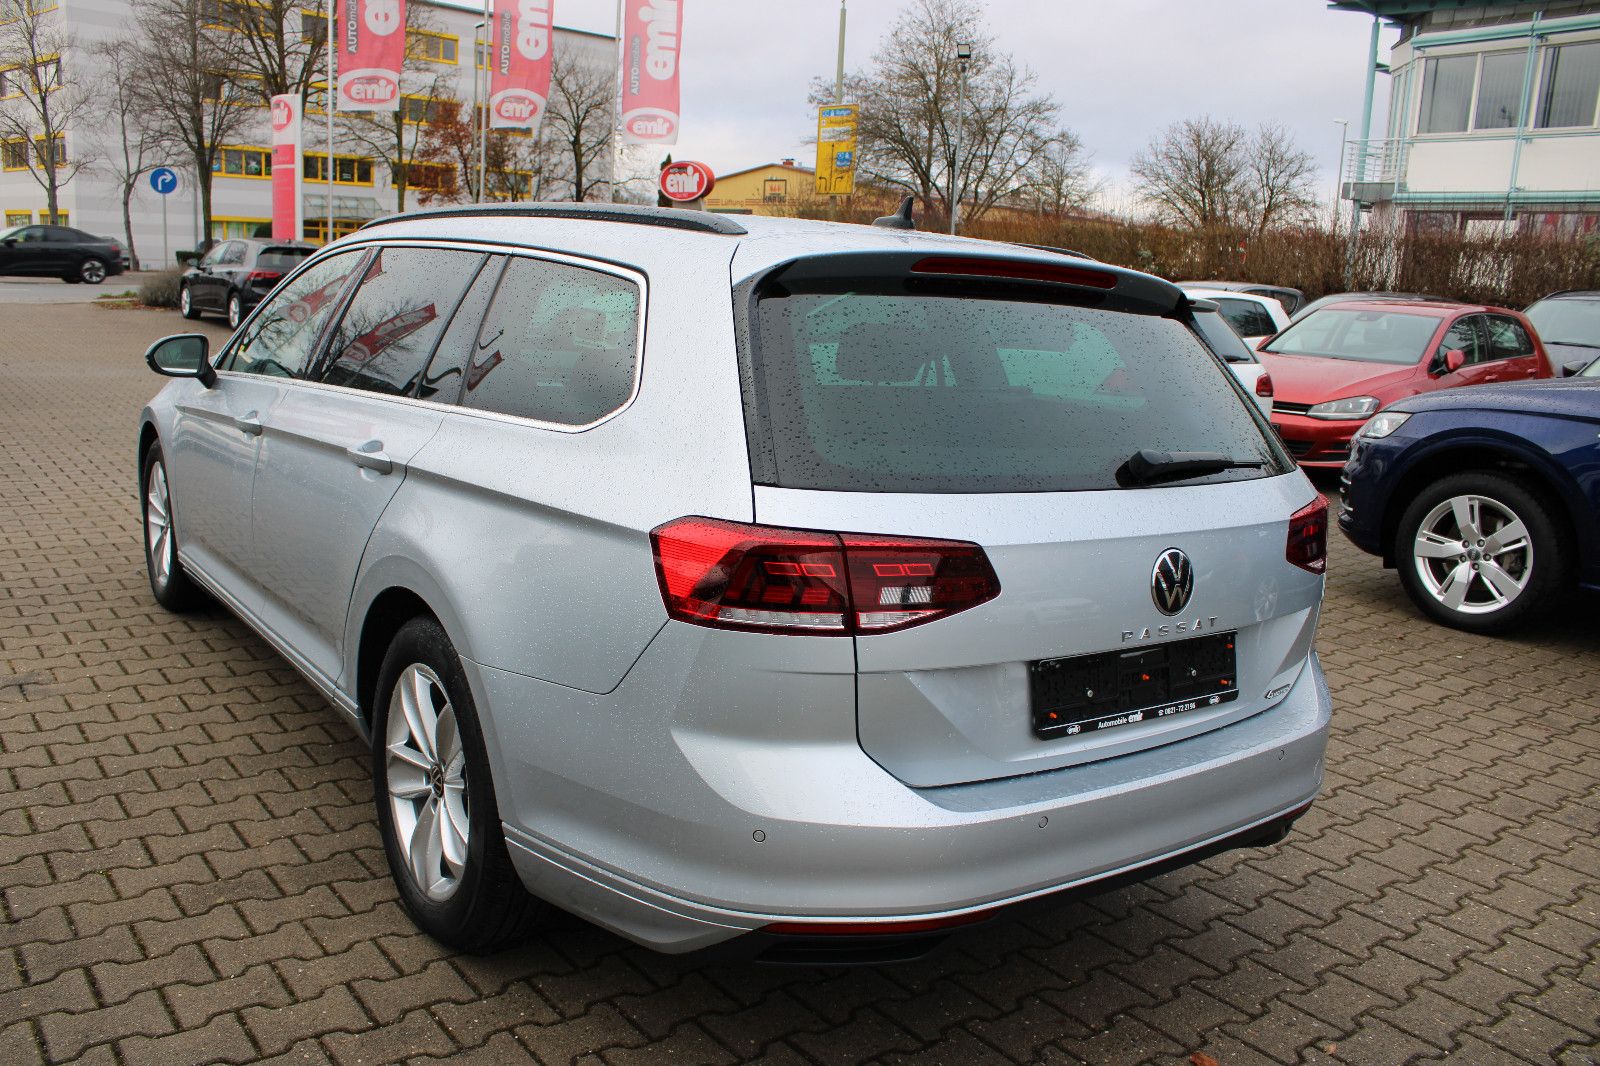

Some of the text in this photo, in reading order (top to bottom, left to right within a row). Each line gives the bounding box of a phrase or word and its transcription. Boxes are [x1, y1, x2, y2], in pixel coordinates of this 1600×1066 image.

[501, 11, 511, 75] AUTOmobile
[350, 79, 393, 99] emir
[500, 100, 534, 117] emir
[632, 118, 670, 134] emir
[666, 165, 699, 192] emir
[1122, 616, 1218, 642] PASSAT
[1098, 717, 1127, 729] Automobile
[1128, 710, 1143, 722] emir
